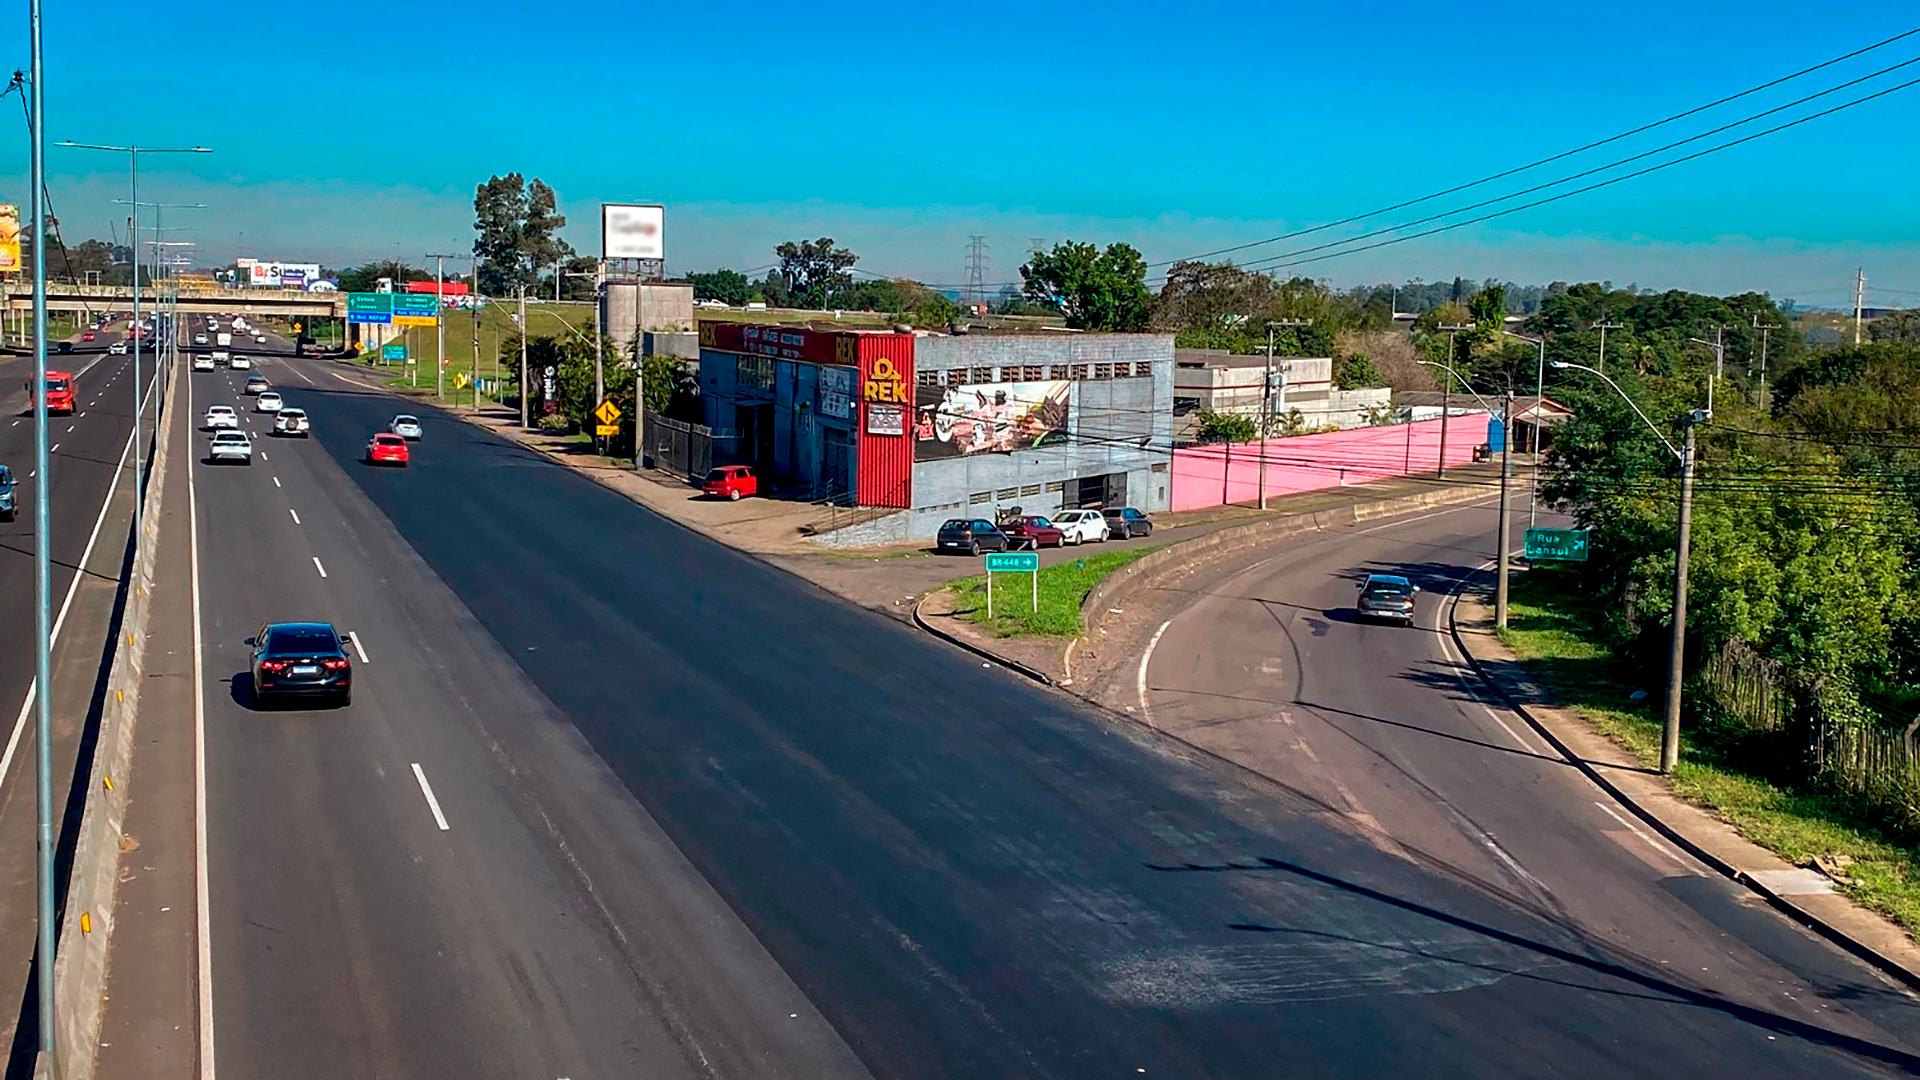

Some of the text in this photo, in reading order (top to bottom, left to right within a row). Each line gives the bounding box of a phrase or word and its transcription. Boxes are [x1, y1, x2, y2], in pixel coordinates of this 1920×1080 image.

[700, 321, 717, 347] REK
[836, 336, 855, 365] REK
[864, 380, 908, 403] REK
[919, 424, 935, 438] REK
[1537, 534, 1560, 543] Rua
[991, 558, 1020, 567] BR-448
